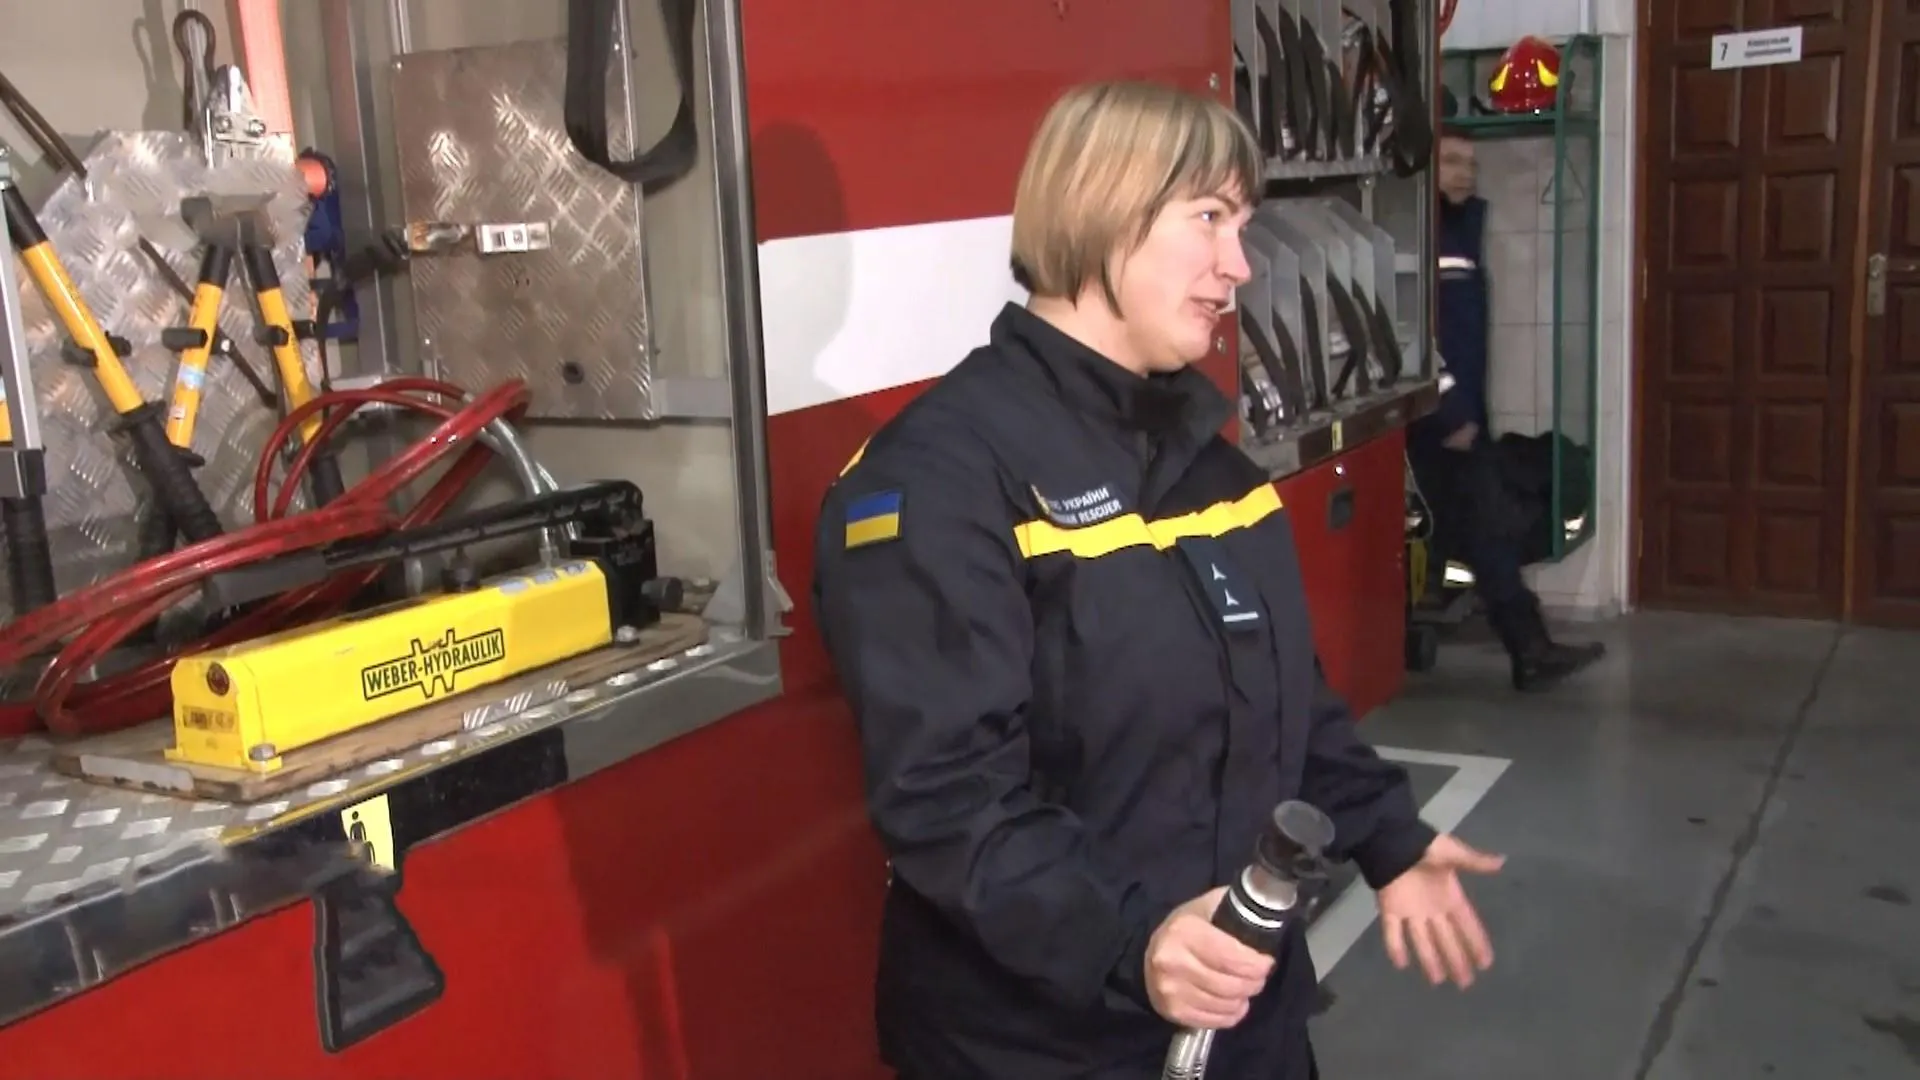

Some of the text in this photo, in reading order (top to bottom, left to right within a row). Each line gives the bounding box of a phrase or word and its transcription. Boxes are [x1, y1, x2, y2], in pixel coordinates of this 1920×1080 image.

[1720, 42, 1729, 60] 7
[1062, 486, 1110, 511] УКРАЇНИ
[1078, 499, 1122, 524] RESCUER
[366, 634, 501, 693] WEBER-HYDRAULIK
